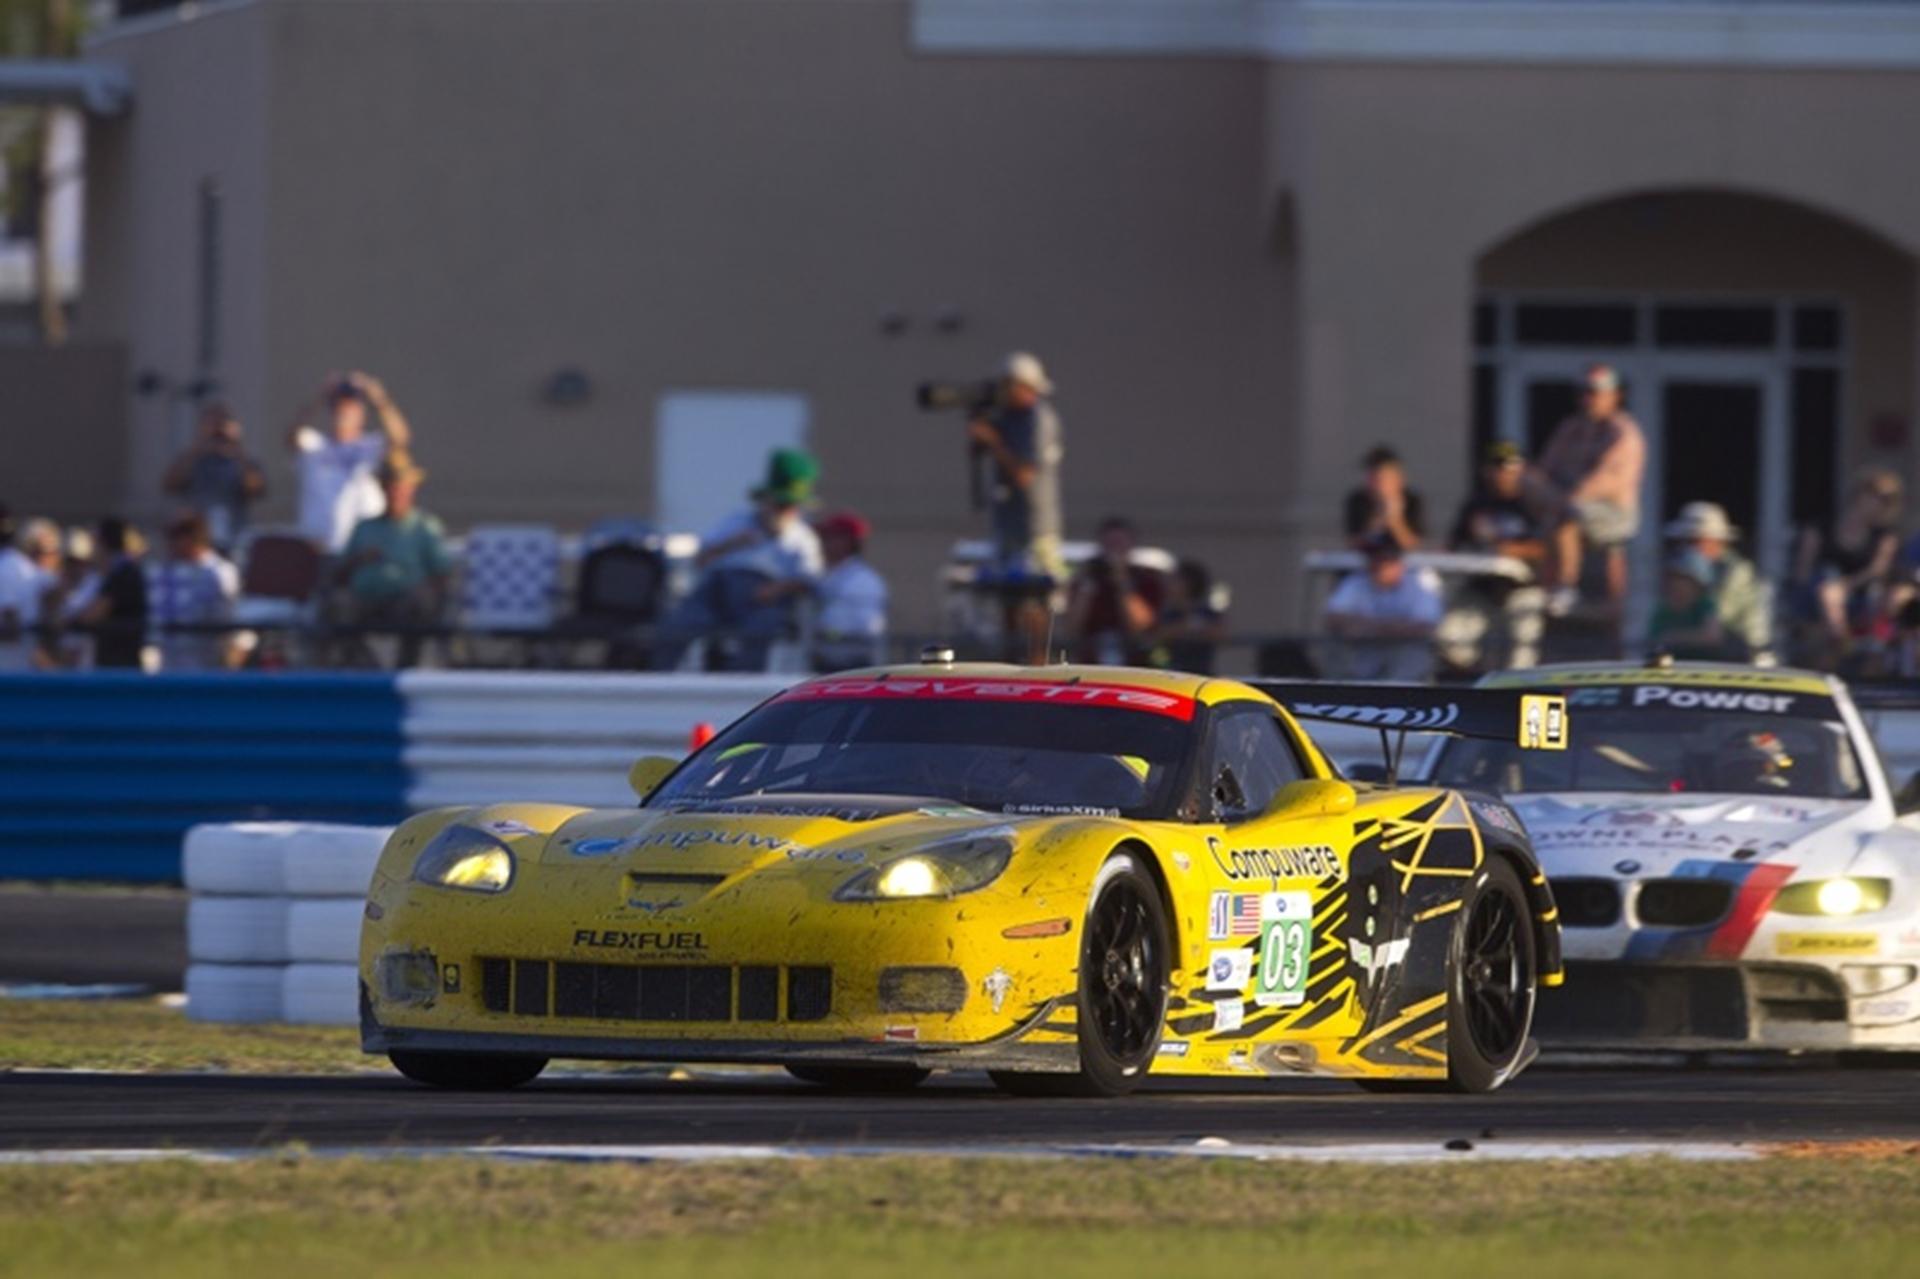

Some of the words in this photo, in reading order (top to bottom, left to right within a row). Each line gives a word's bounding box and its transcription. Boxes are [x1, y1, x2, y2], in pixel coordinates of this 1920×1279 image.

[1632, 686, 1796, 713] Power
[570, 829, 866, 864] Cmpuware
[1207, 836, 1342, 892] Compuware
[573, 930, 710, 950] FLEXFUEL
[1262, 920, 1304, 992] 03
